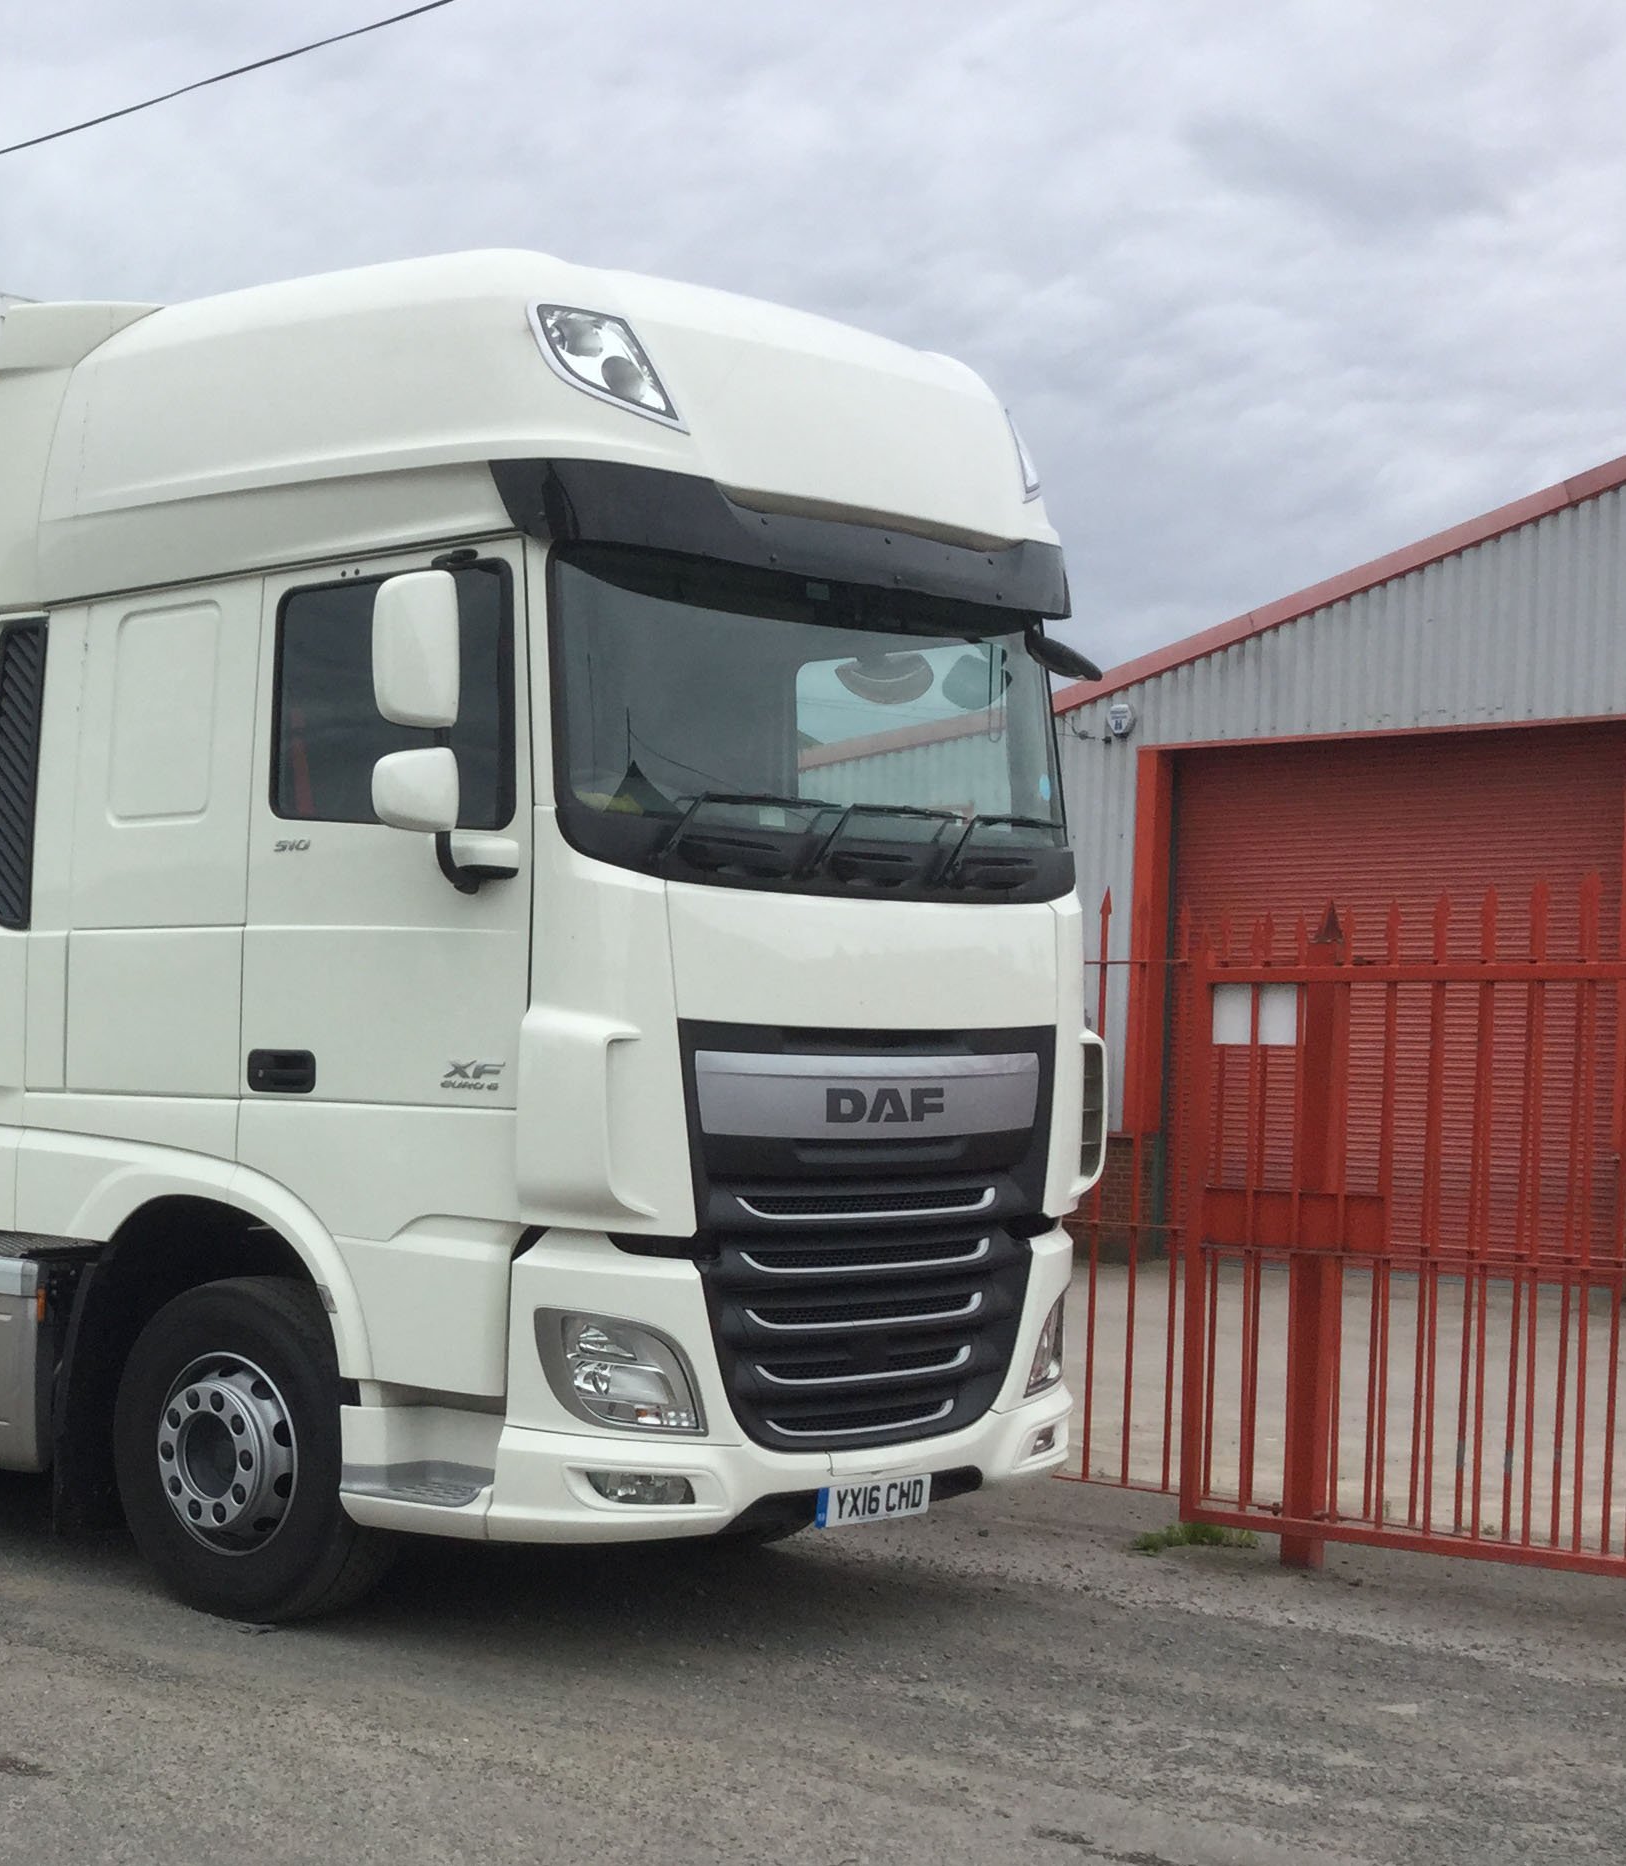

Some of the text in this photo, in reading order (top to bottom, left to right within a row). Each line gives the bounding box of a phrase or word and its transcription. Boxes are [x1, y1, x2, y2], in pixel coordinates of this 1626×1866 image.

[273, 839, 311, 852] 510
[443, 1059, 506, 1079] XF
[825, 1087, 944, 1122] DAF
[837, 1479, 923, 1519] YX16 CHD
